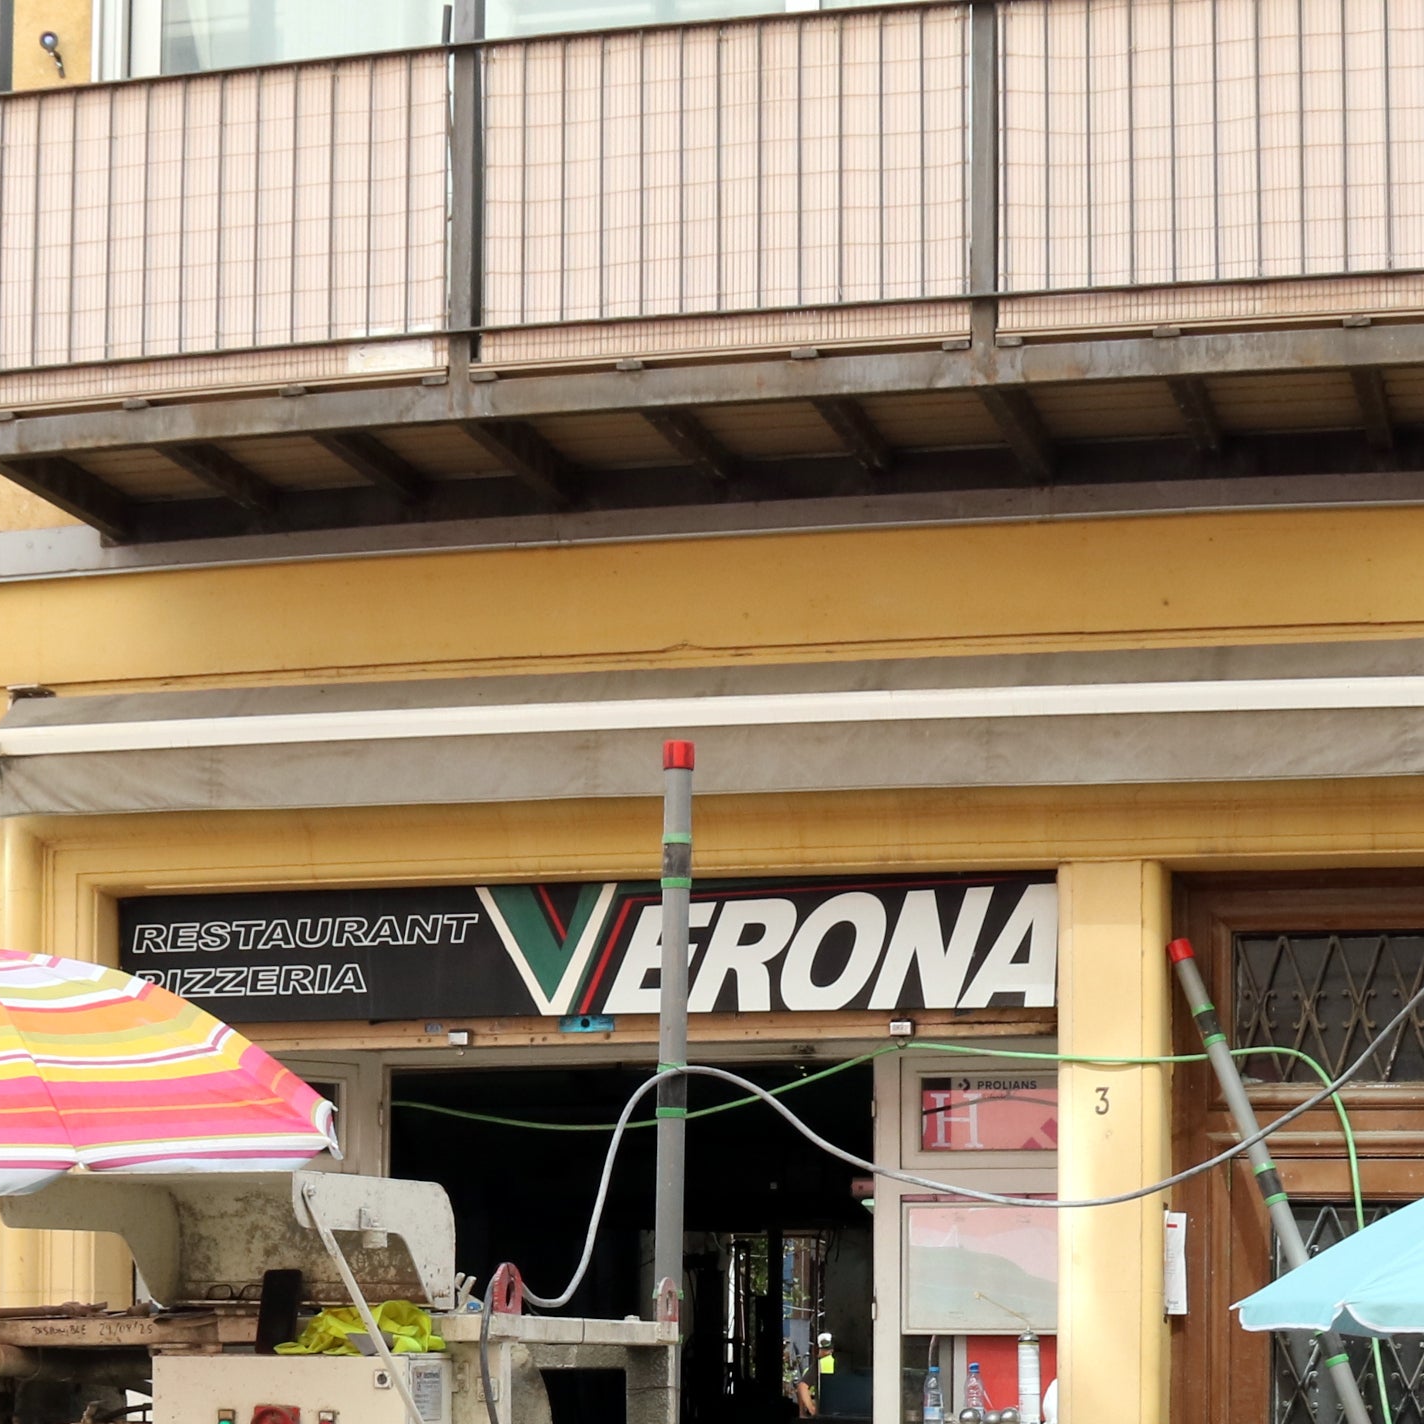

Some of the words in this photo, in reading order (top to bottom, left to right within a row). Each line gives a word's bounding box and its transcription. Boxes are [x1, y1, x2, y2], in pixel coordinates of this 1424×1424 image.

[132, 913, 478, 954] RESTAURANT
[476, 882, 1059, 1016] VERONA
[134, 963, 367, 998] PIZZERIA
[977, 1080, 1037, 1090] PROLIANS
[1095, 1087, 1110, 1115] 3
